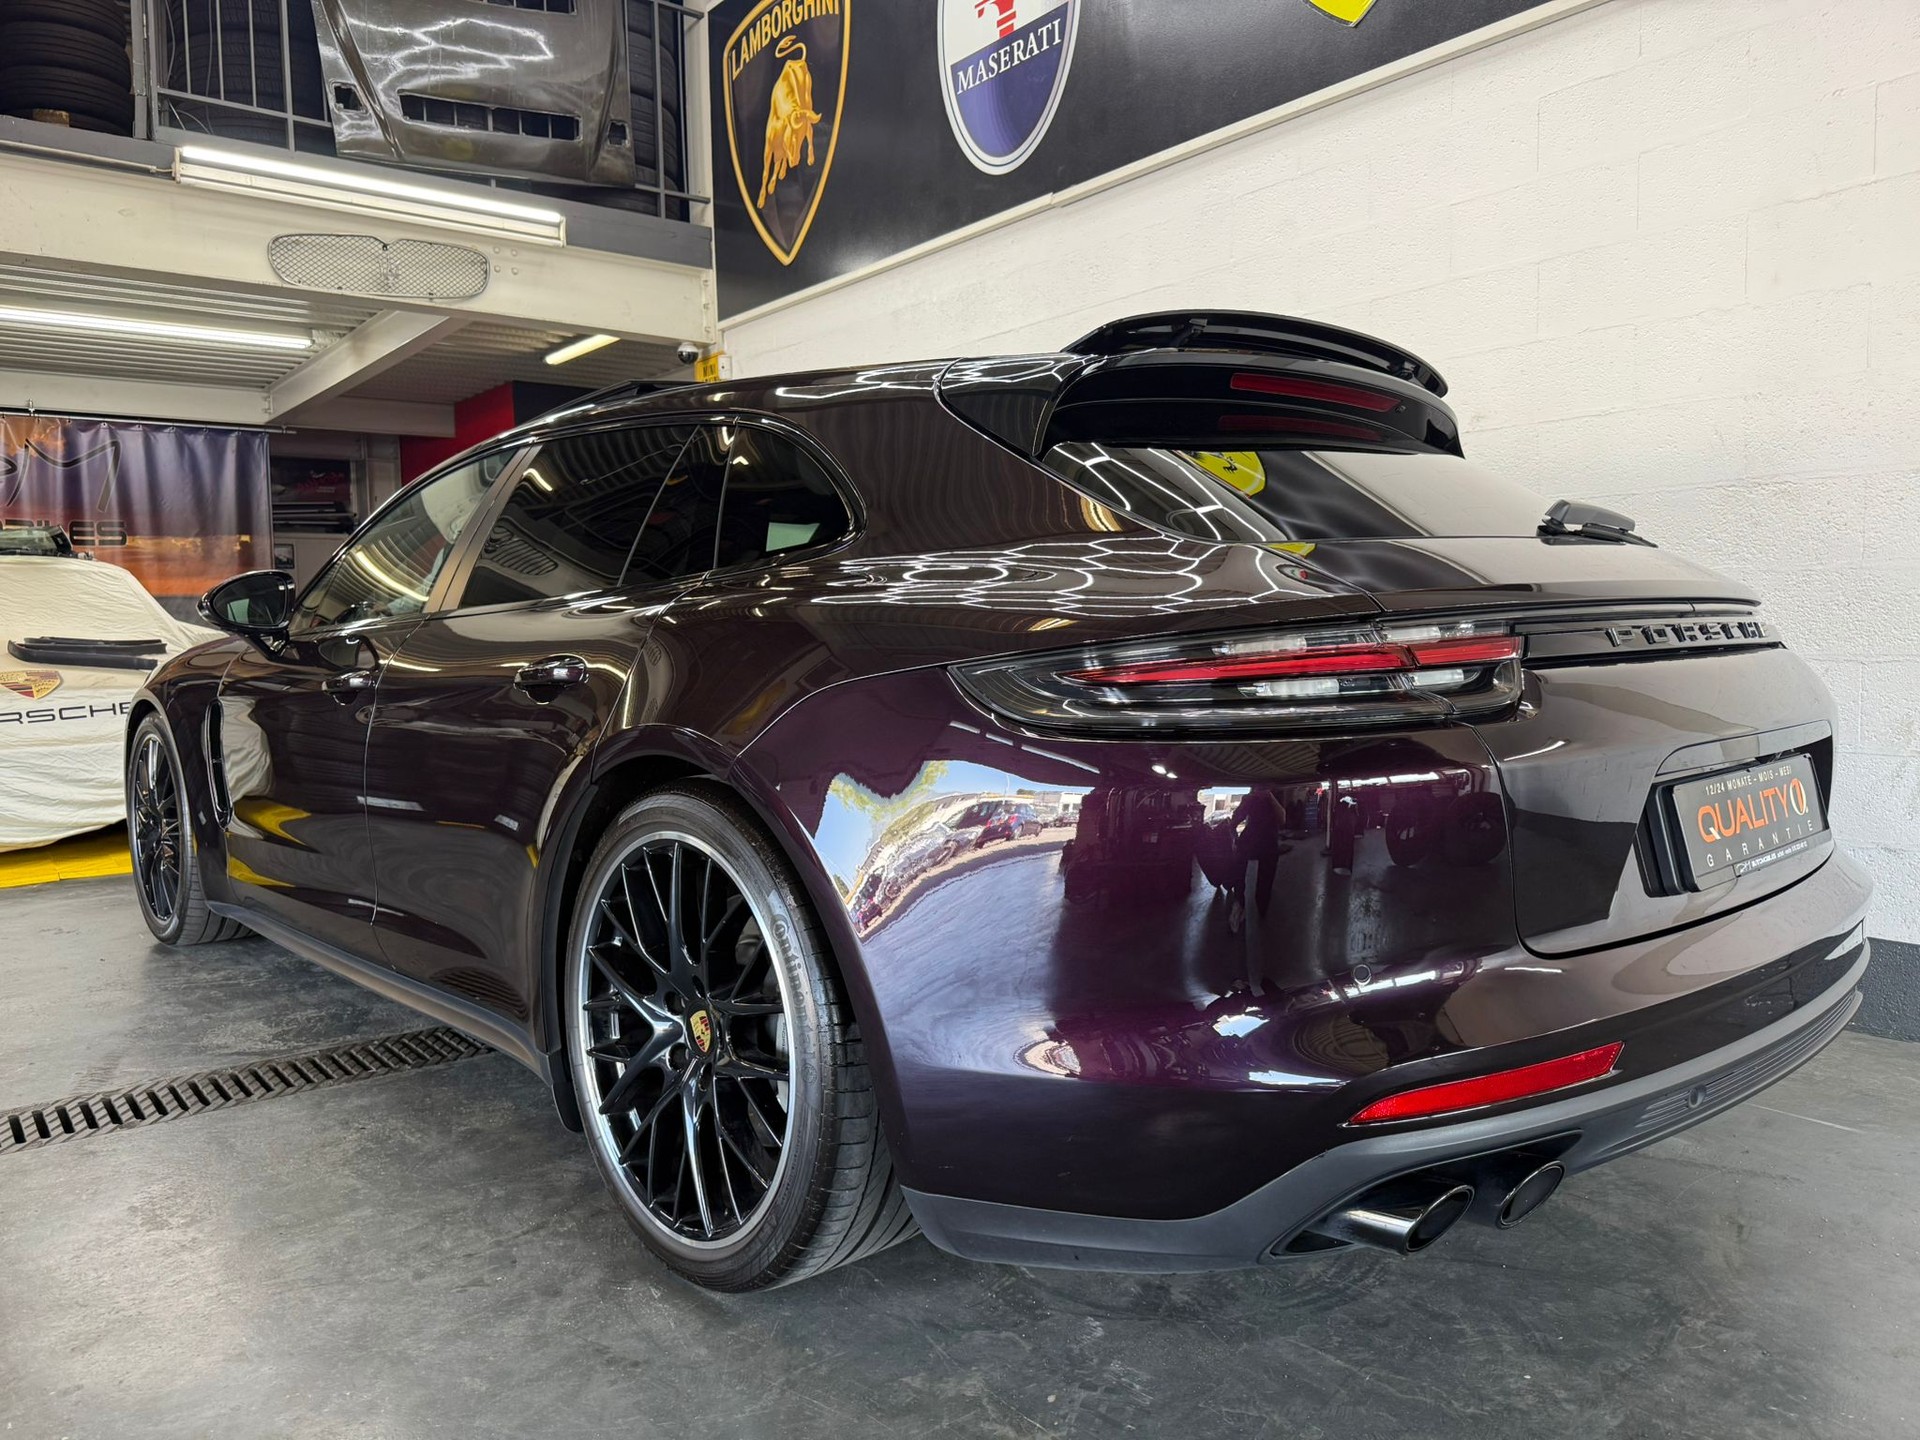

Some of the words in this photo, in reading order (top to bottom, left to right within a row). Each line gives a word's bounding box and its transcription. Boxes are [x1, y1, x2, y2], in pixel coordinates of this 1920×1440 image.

[731, 0, 839, 80] LAMBORGHINI
[956, 18, 1062, 95] MASERATI
[1604, 621, 1768, 648] PORSCH
[0, 701, 132, 724] RSCHE
[1705, 782, 1725, 796] 12/24
[1726, 775, 1752, 791] MONATE
[1758, 769, 1774, 782] MOIS
[1706, 819, 1813, 868] GARANTIE
